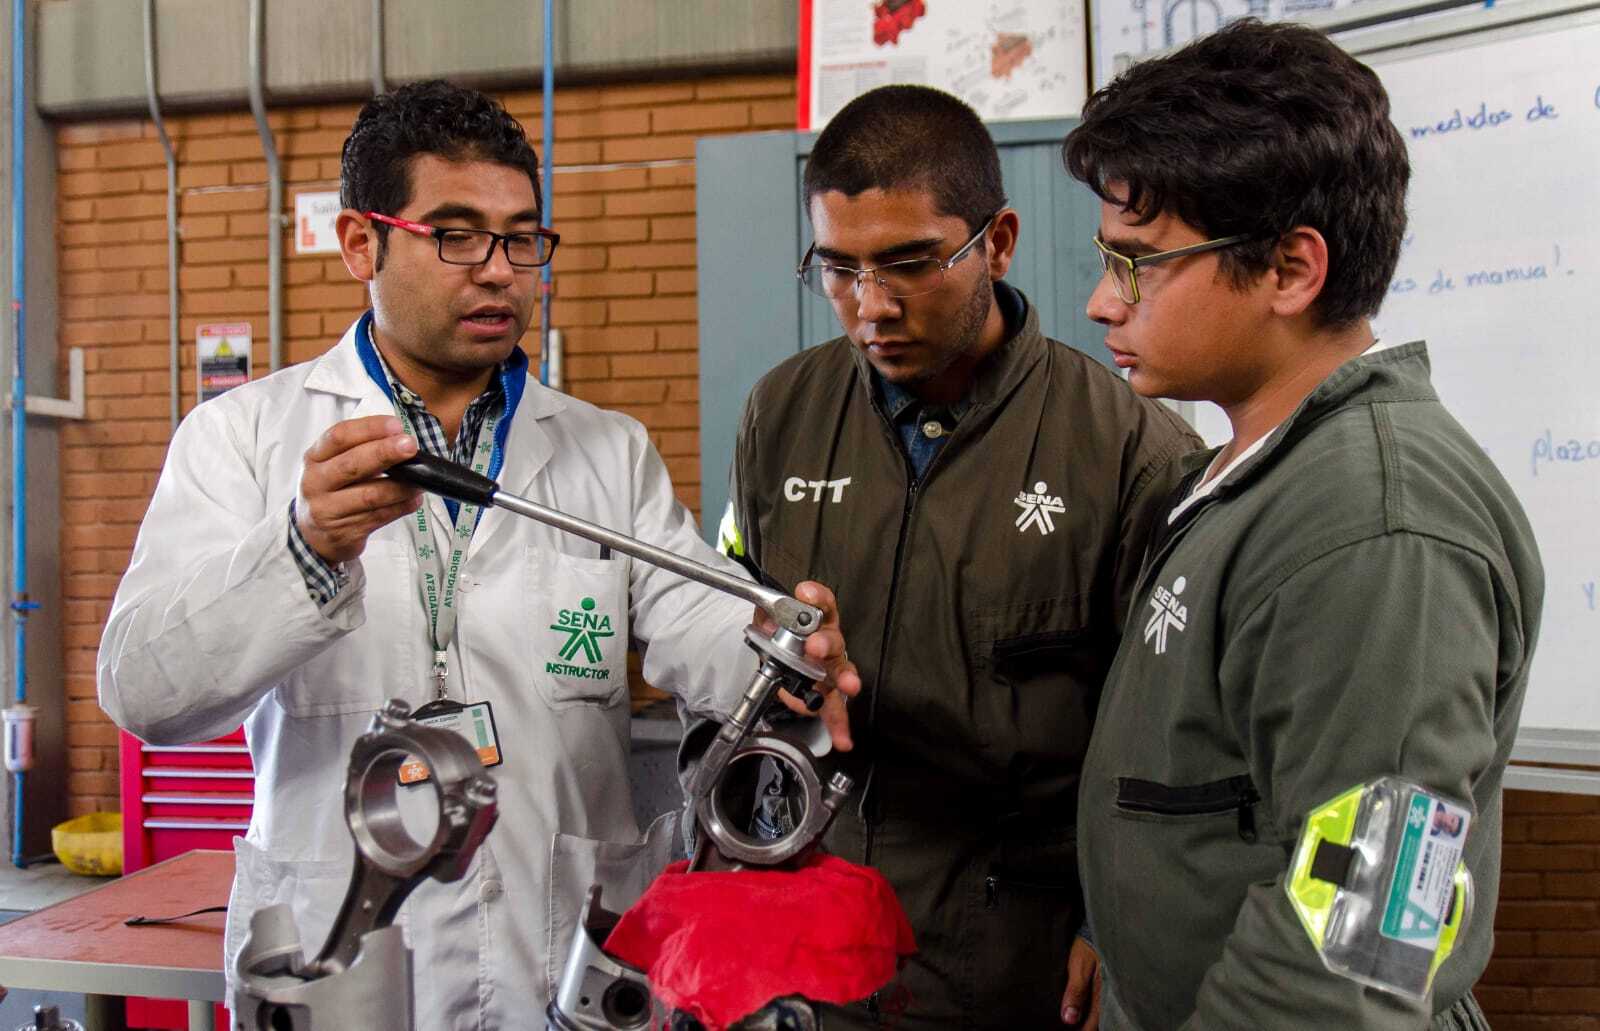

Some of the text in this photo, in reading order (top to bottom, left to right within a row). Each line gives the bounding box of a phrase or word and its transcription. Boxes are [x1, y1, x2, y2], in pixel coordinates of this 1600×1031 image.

[1526, 95, 1559, 122] de
[1429, 270, 1455, 294] de
[784, 476, 851, 503] CTT
[1018, 490, 1065, 508] SENA
[1154, 585, 1188, 624] SENA
[558, 608, 611, 631] SENA
[546, 662, 610, 680] INSTRUCTOR
